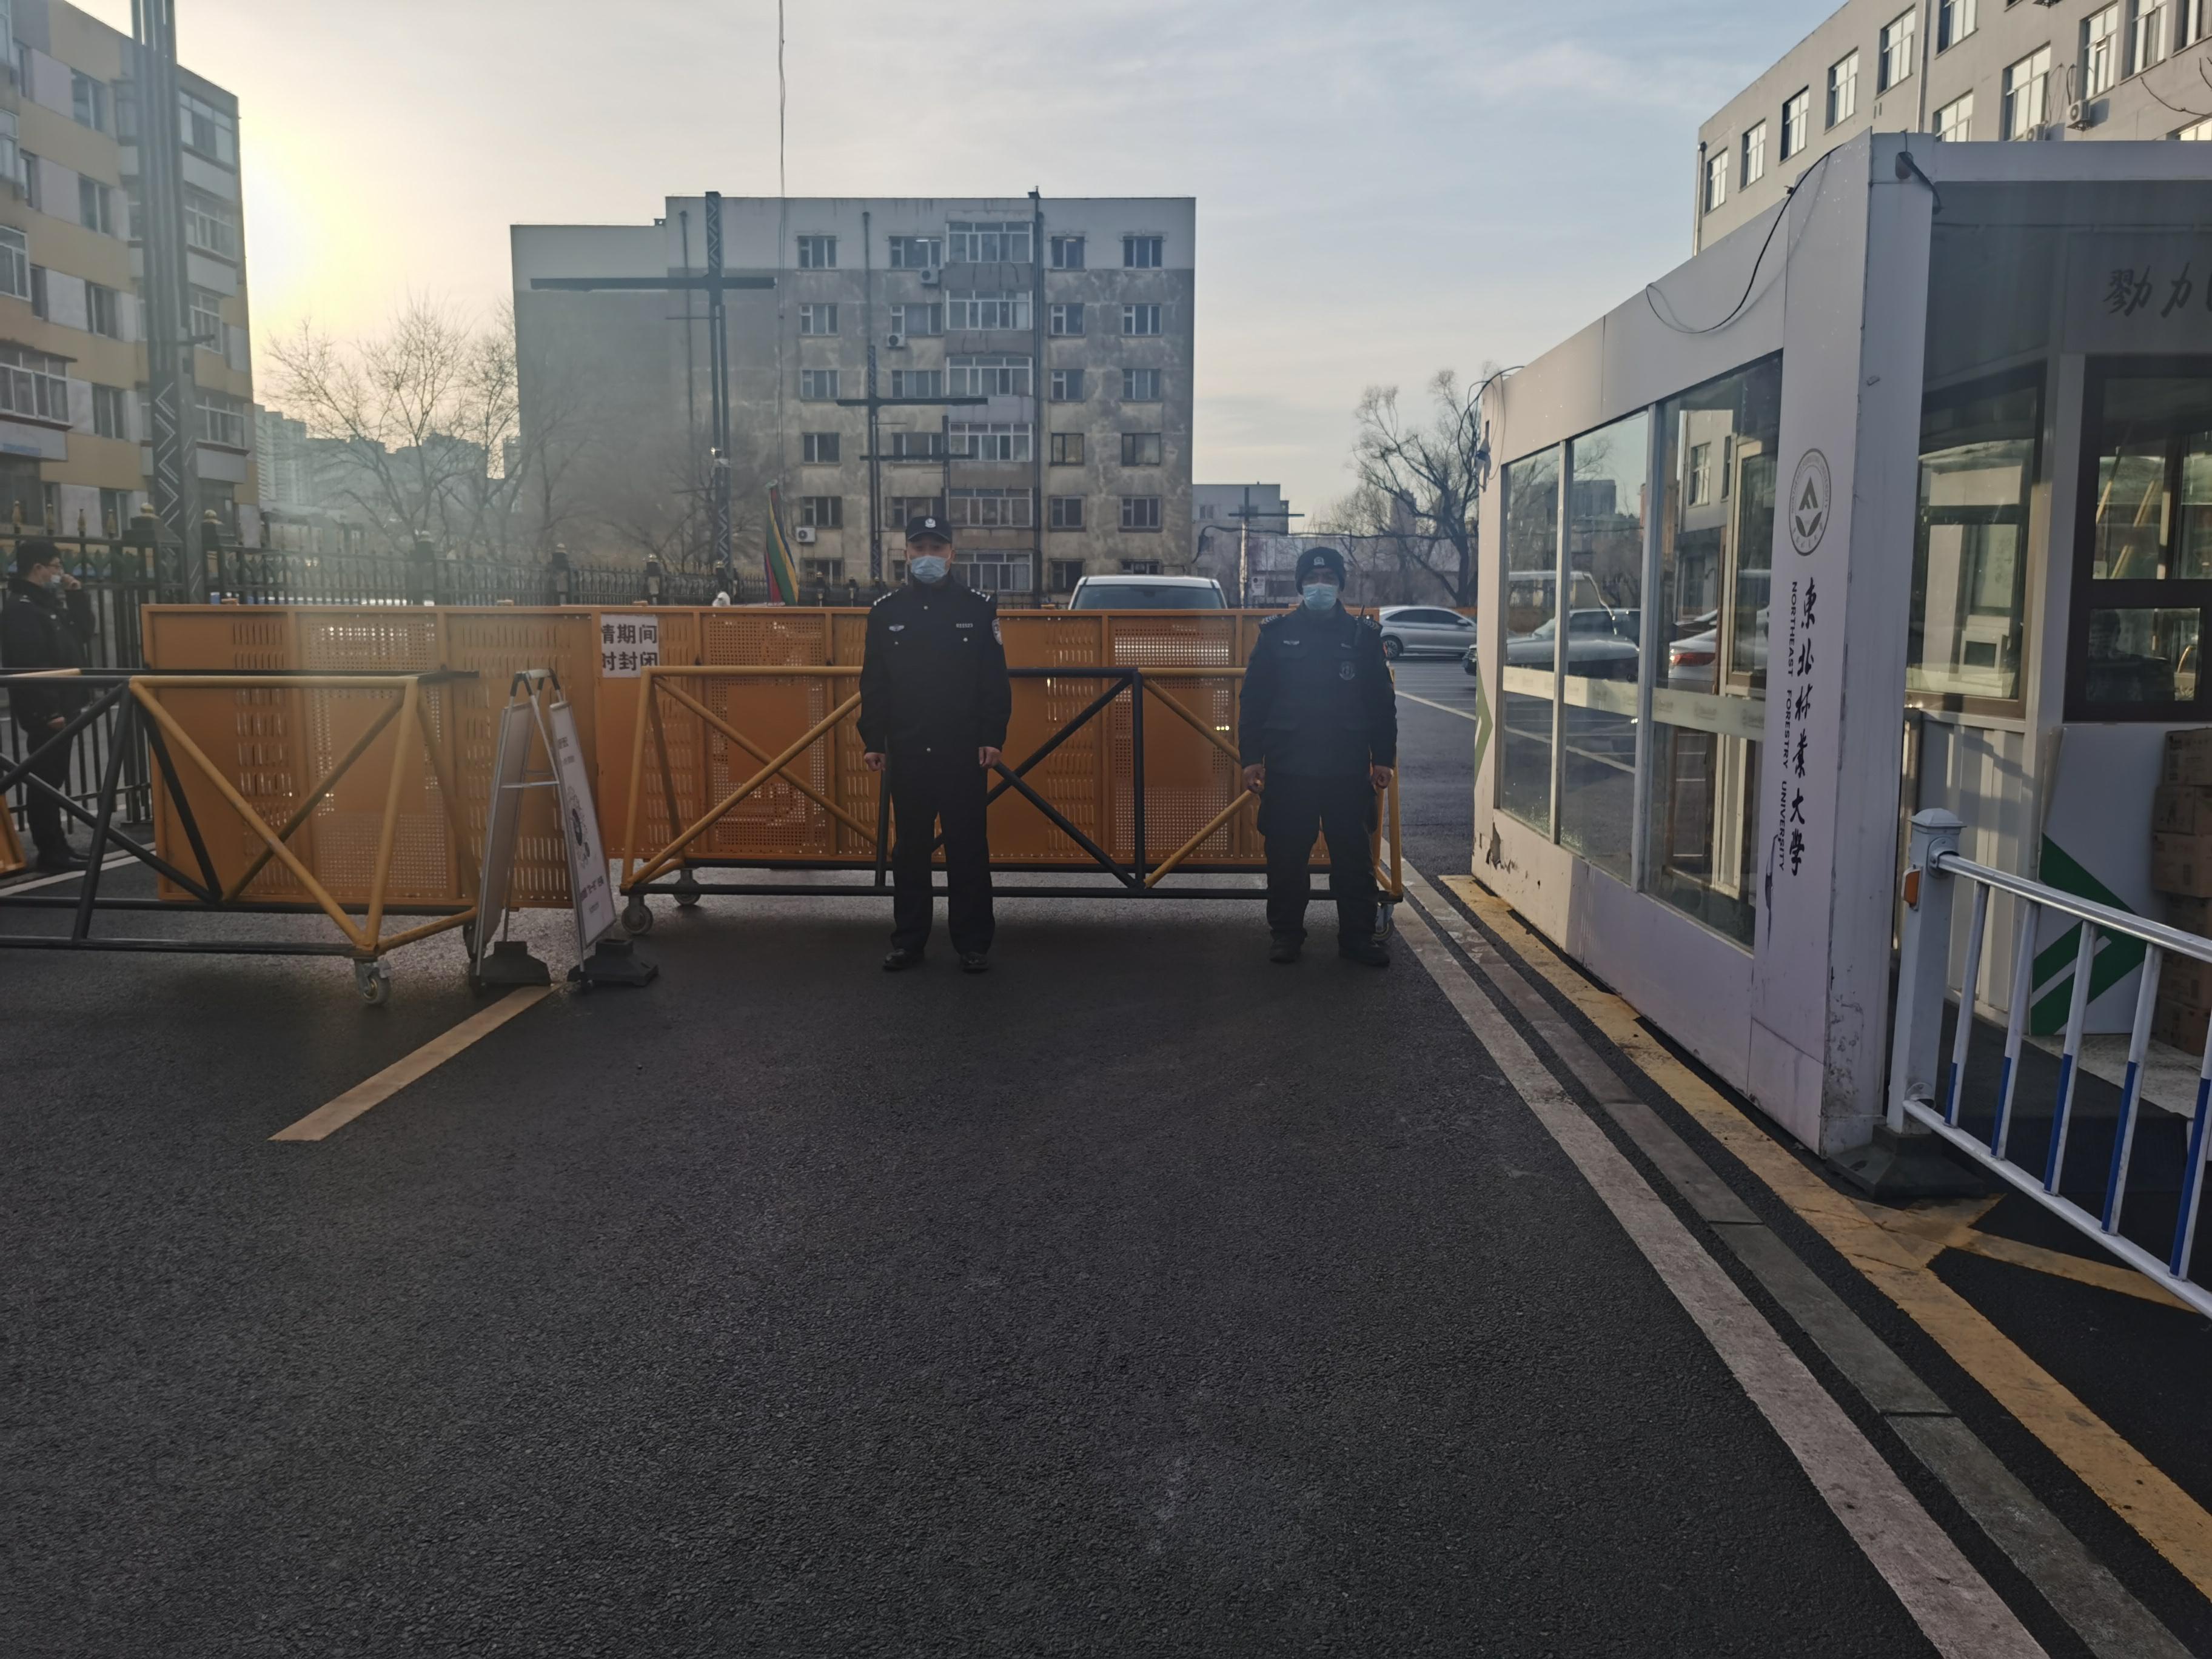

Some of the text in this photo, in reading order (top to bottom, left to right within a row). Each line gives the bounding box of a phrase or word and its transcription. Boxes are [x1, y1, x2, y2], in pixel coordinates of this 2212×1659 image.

[1778, 581, 1798, 871] NORTHEAST FORESTRY UNIVERSITY
